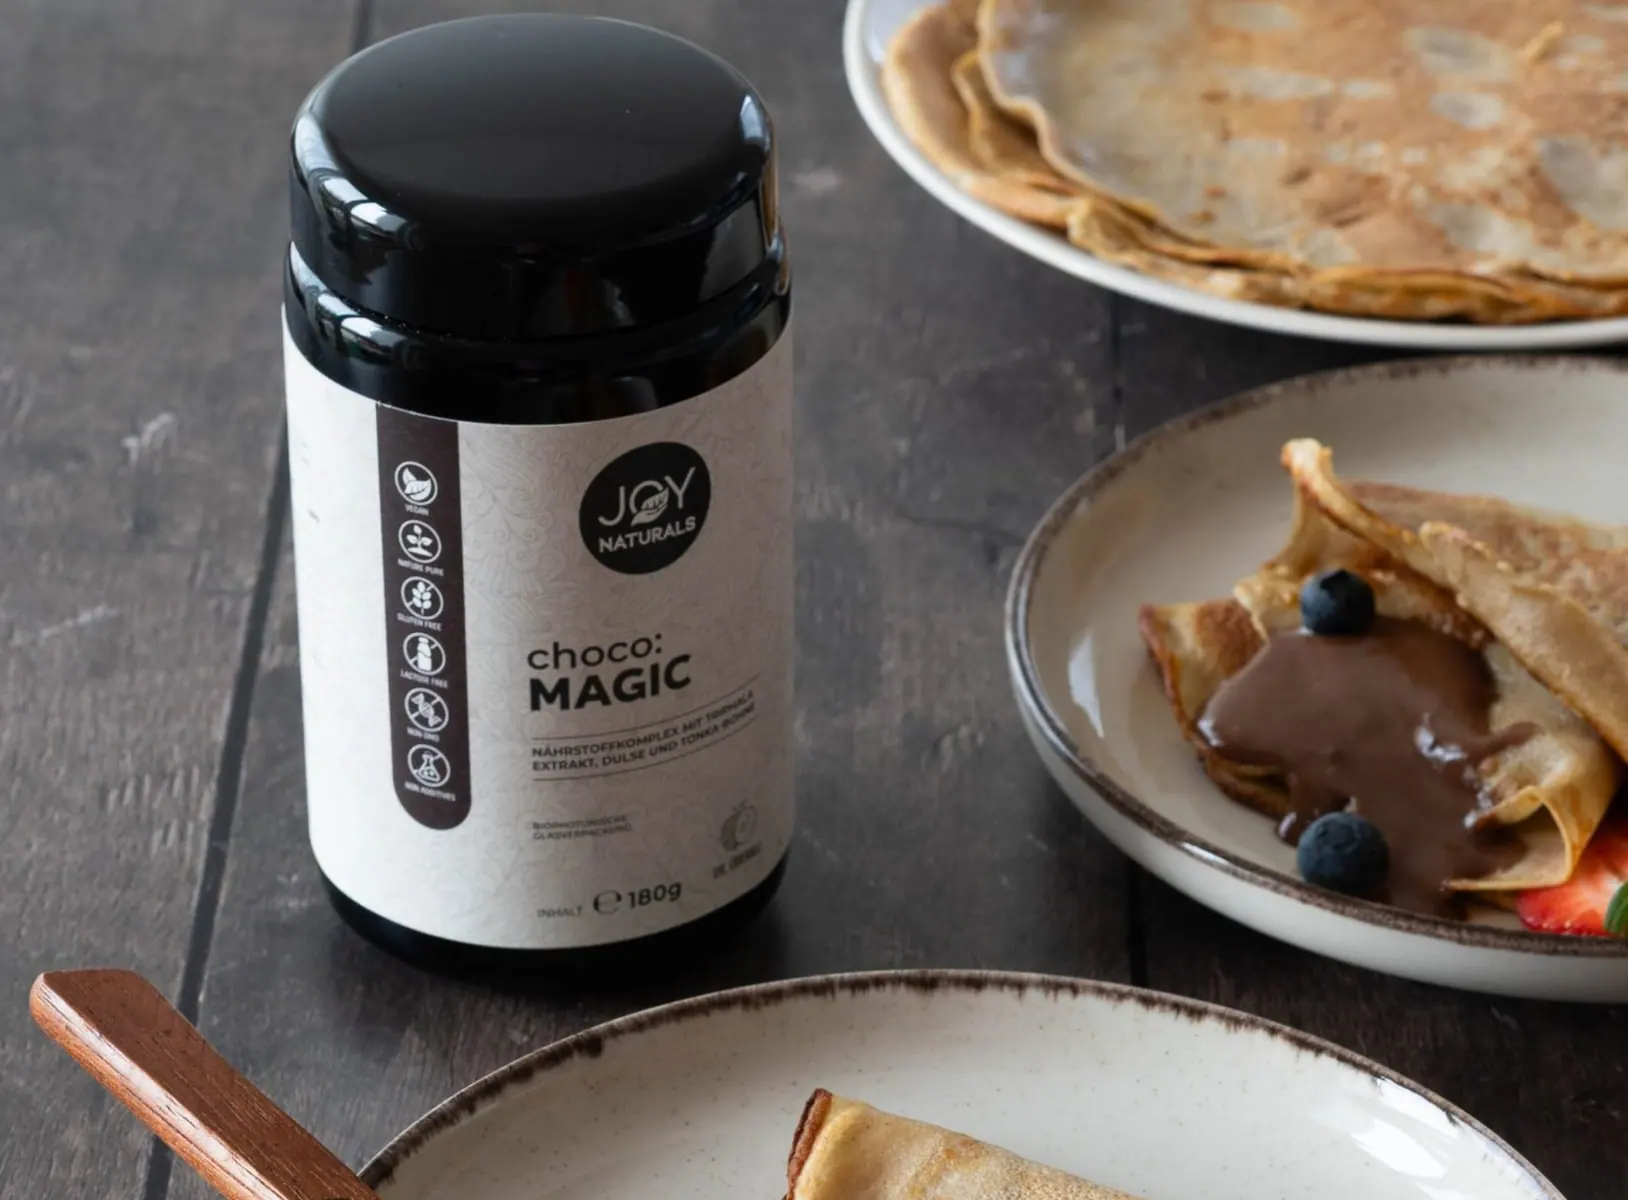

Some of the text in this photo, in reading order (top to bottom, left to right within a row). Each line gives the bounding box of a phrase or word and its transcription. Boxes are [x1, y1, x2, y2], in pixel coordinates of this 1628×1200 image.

[598, 467, 696, 526] JOY
[599, 516, 696, 553] NATURALS
[424, 620, 441, 632] FREE
[527, 633, 662, 670] choco:
[431, 677, 448, 689] FREE
[529, 654, 692, 712] MAGIC
[682, 716, 703, 734] MIT
[602, 751, 646, 767] DULSE
[649, 741, 679, 757] UND
[628, 882, 682, 908] 180g
